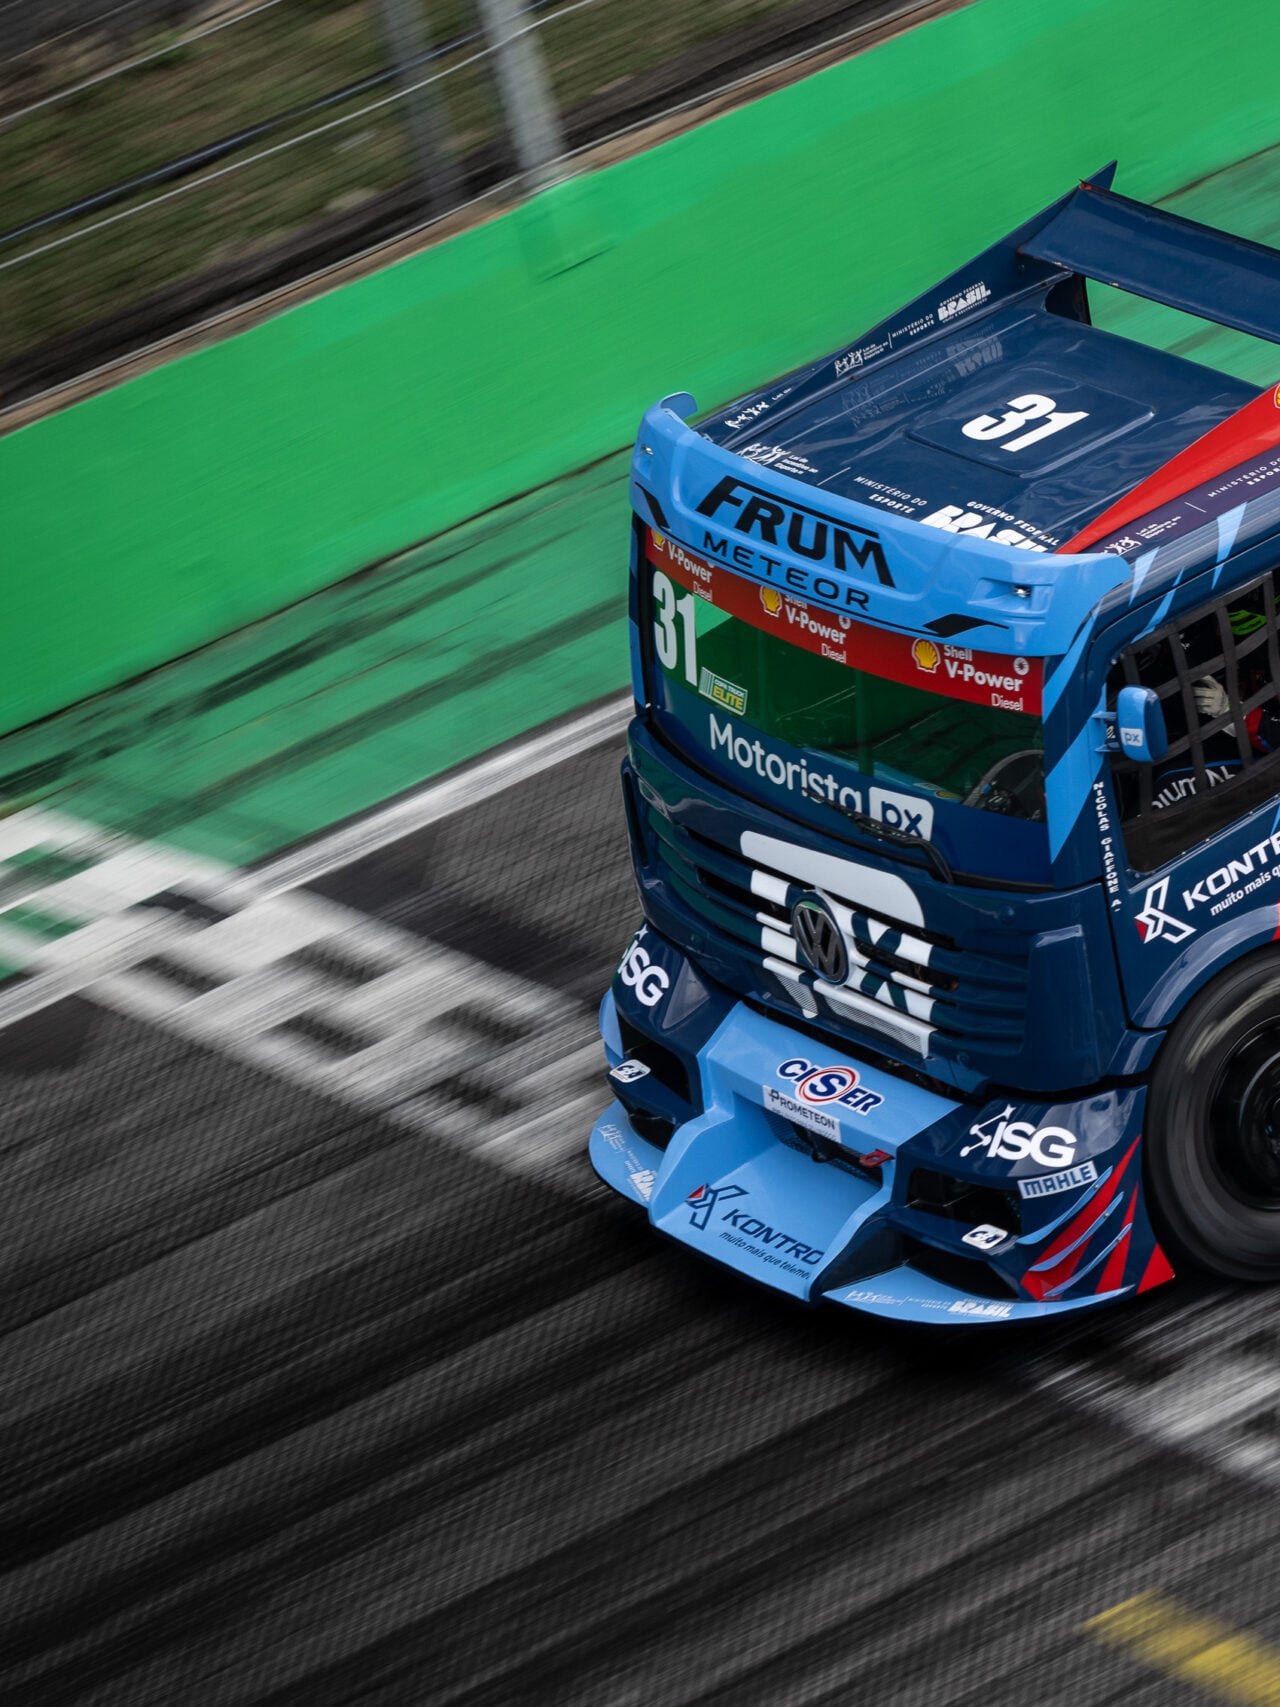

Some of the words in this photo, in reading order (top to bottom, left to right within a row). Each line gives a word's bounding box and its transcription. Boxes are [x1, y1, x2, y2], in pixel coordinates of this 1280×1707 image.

[938, 284, 992, 321] BRASIL
[961, 393, 1090, 453] 31
[853, 476, 911, 501] MINISTÉRIO
[911, 496, 928, 507] DO
[868, 493, 915, 514] ESPORTE
[966, 501, 1015, 522] GOVERNO
[695, 475, 897, 589] FRUM
[667, 542, 712, 583] V-Power
[703, 531, 870, 612] METEOR
[692, 581, 713, 602] Diesel
[653, 570, 698, 687] 31
[785, 604, 846, 645] V-Power
[821, 643, 847, 664] Diesel
[943, 644, 973, 661] Shell
[944, 659, 1024, 692] V-Power
[712, 685, 744, 710] ELITE
[991, 693, 1024, 712] Diesel
[1123, 732, 1140, 744] px
[710, 713, 863, 818] Motorista
[1093, 781, 1110, 832] NICOLAS
[1100, 837, 1119, 894] GIAFFONE
[1210, 888, 1244, 917] muito
[1243, 871, 1272, 896] mais
[778, 1059, 883, 1112] CISER
[767, 1088, 836, 1130] PROMETEON
[986, 1121, 1077, 1168] ISG
[1023, 1165, 1093, 1196] MAHLE
[719, 1232, 745, 1248] muito
[743, 1243, 765, 1258] mais
[763, 1254, 782, 1266] que
[721, 1208, 825, 1265] KONTRO
